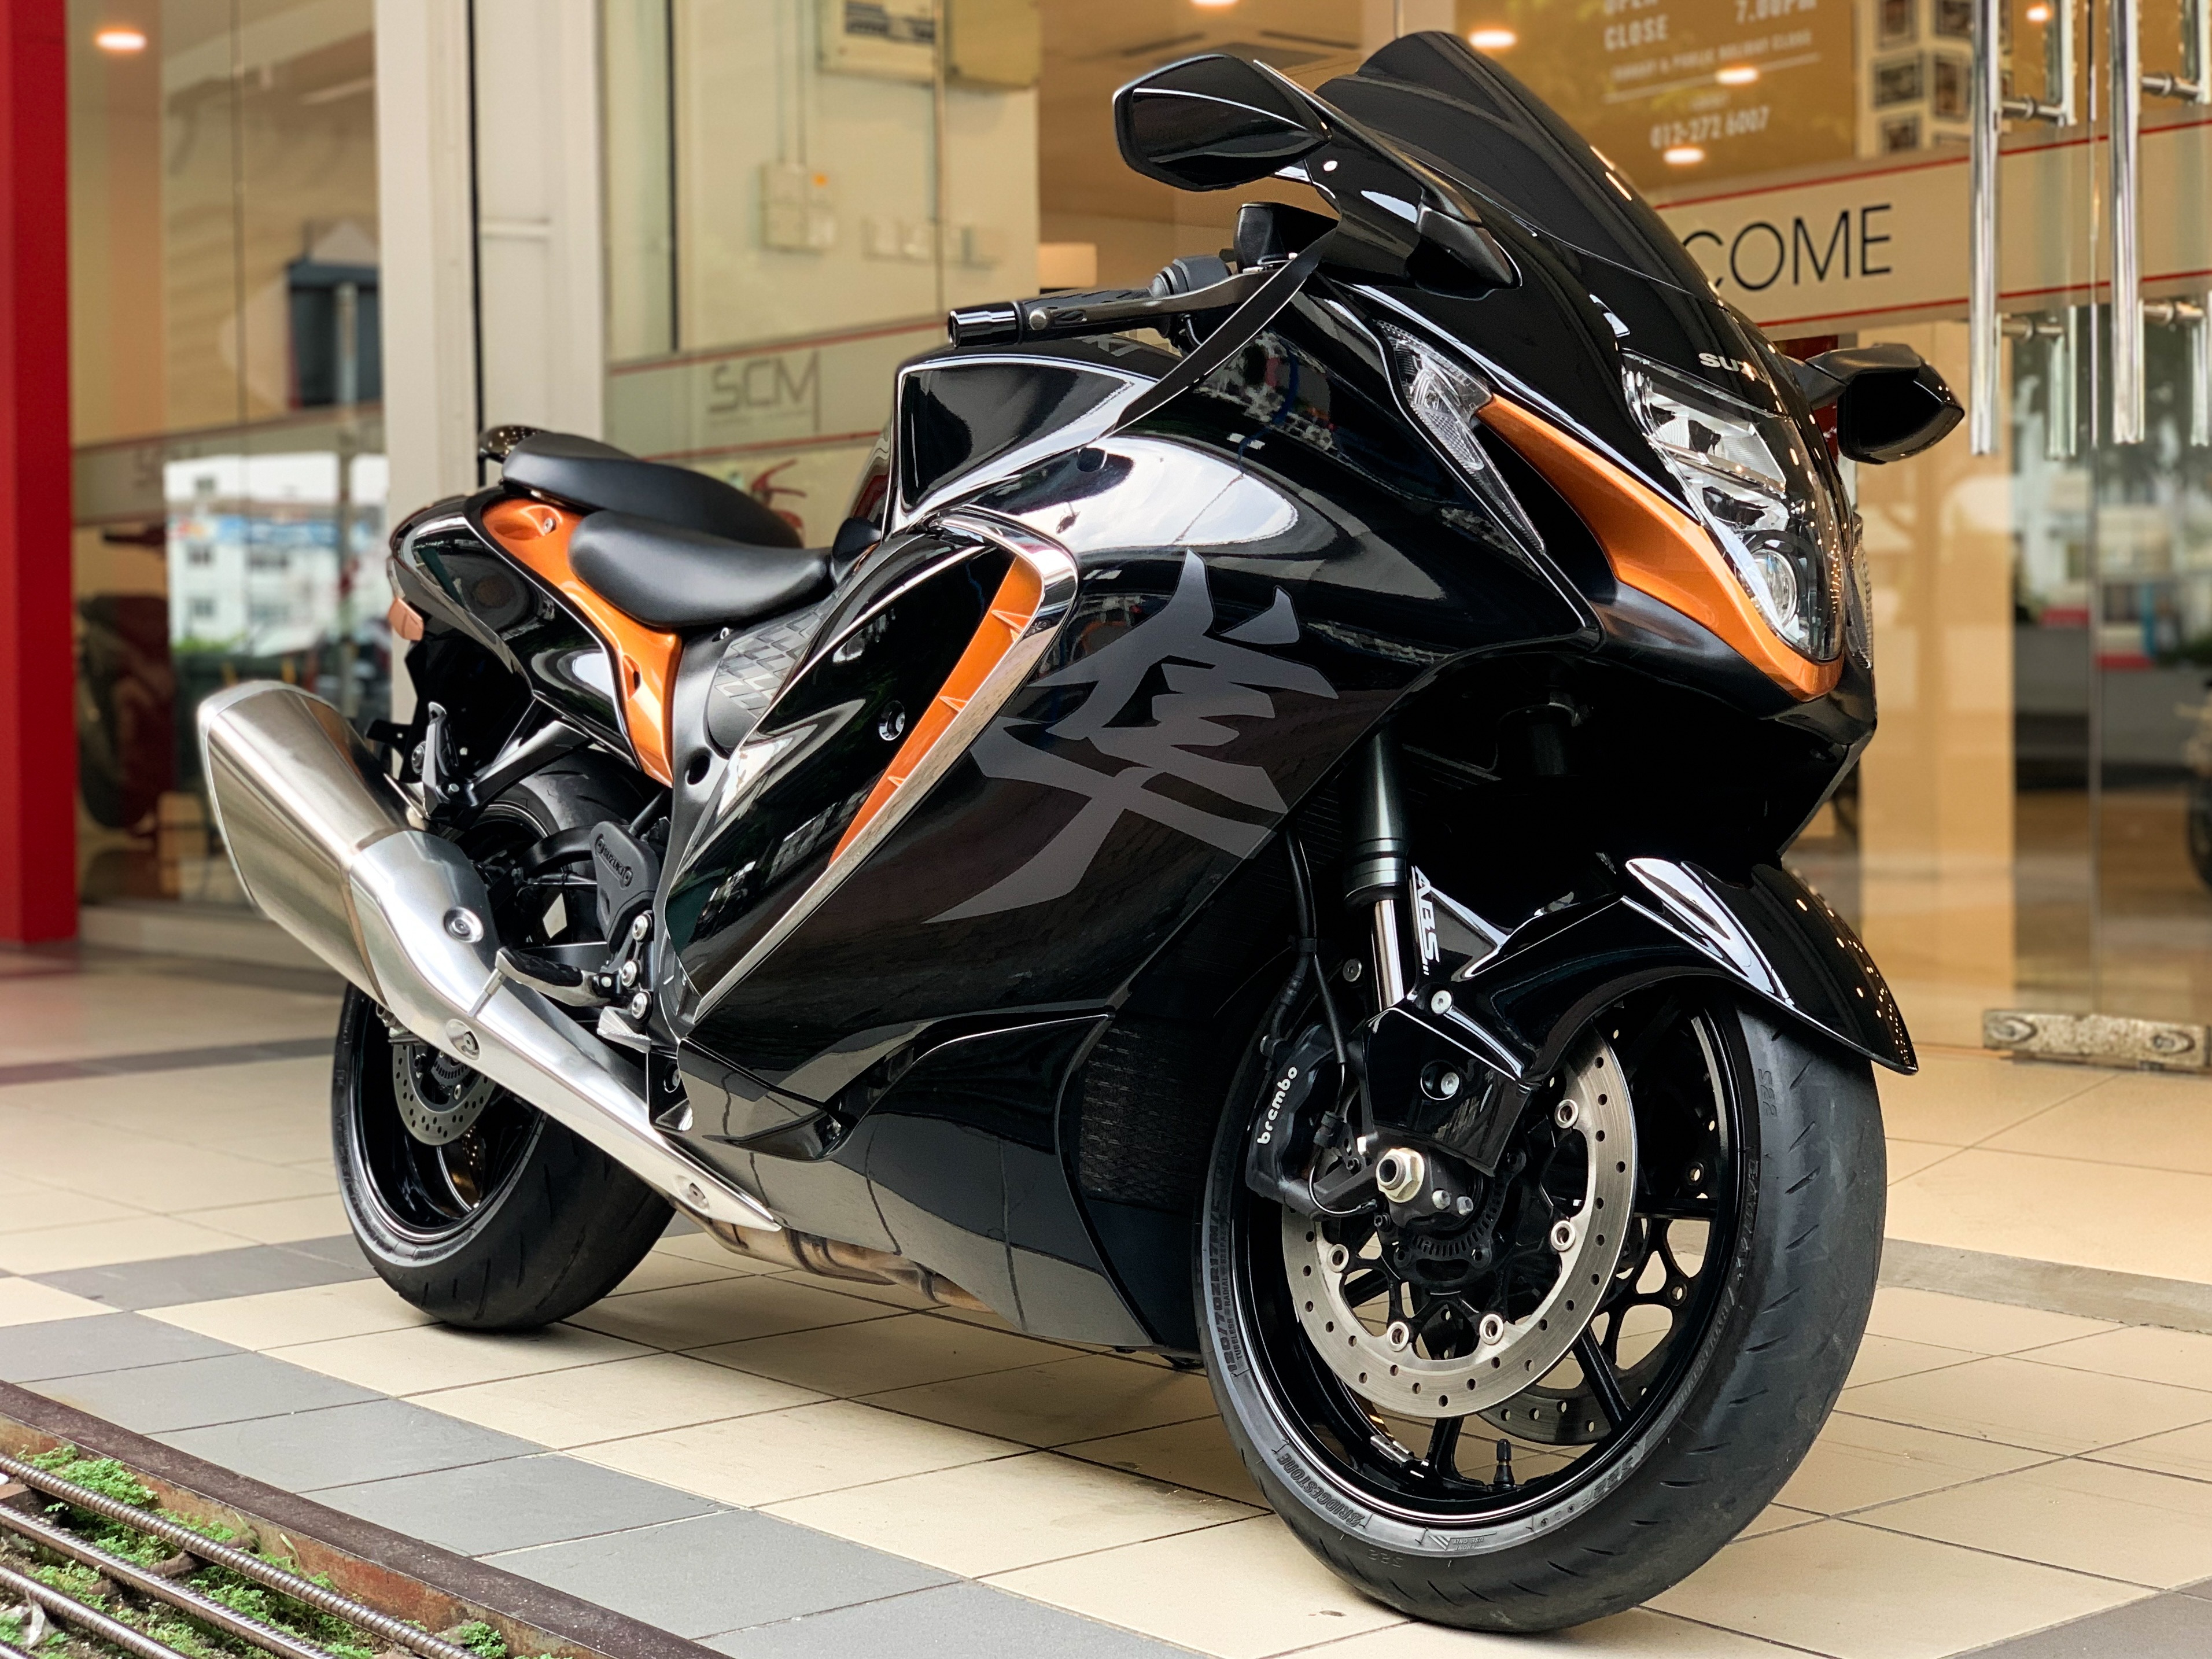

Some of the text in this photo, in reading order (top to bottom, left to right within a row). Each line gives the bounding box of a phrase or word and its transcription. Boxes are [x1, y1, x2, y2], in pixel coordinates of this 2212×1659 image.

[1604, 14, 1668, 51] CLOSE
[1415, 865, 1440, 963] ABS
[1257, 1067, 1297, 1144] brembo
[1221, 1277, 1231, 1307] RADIAL
[1277, 1452, 1365, 1528] BRIDGESTONE
